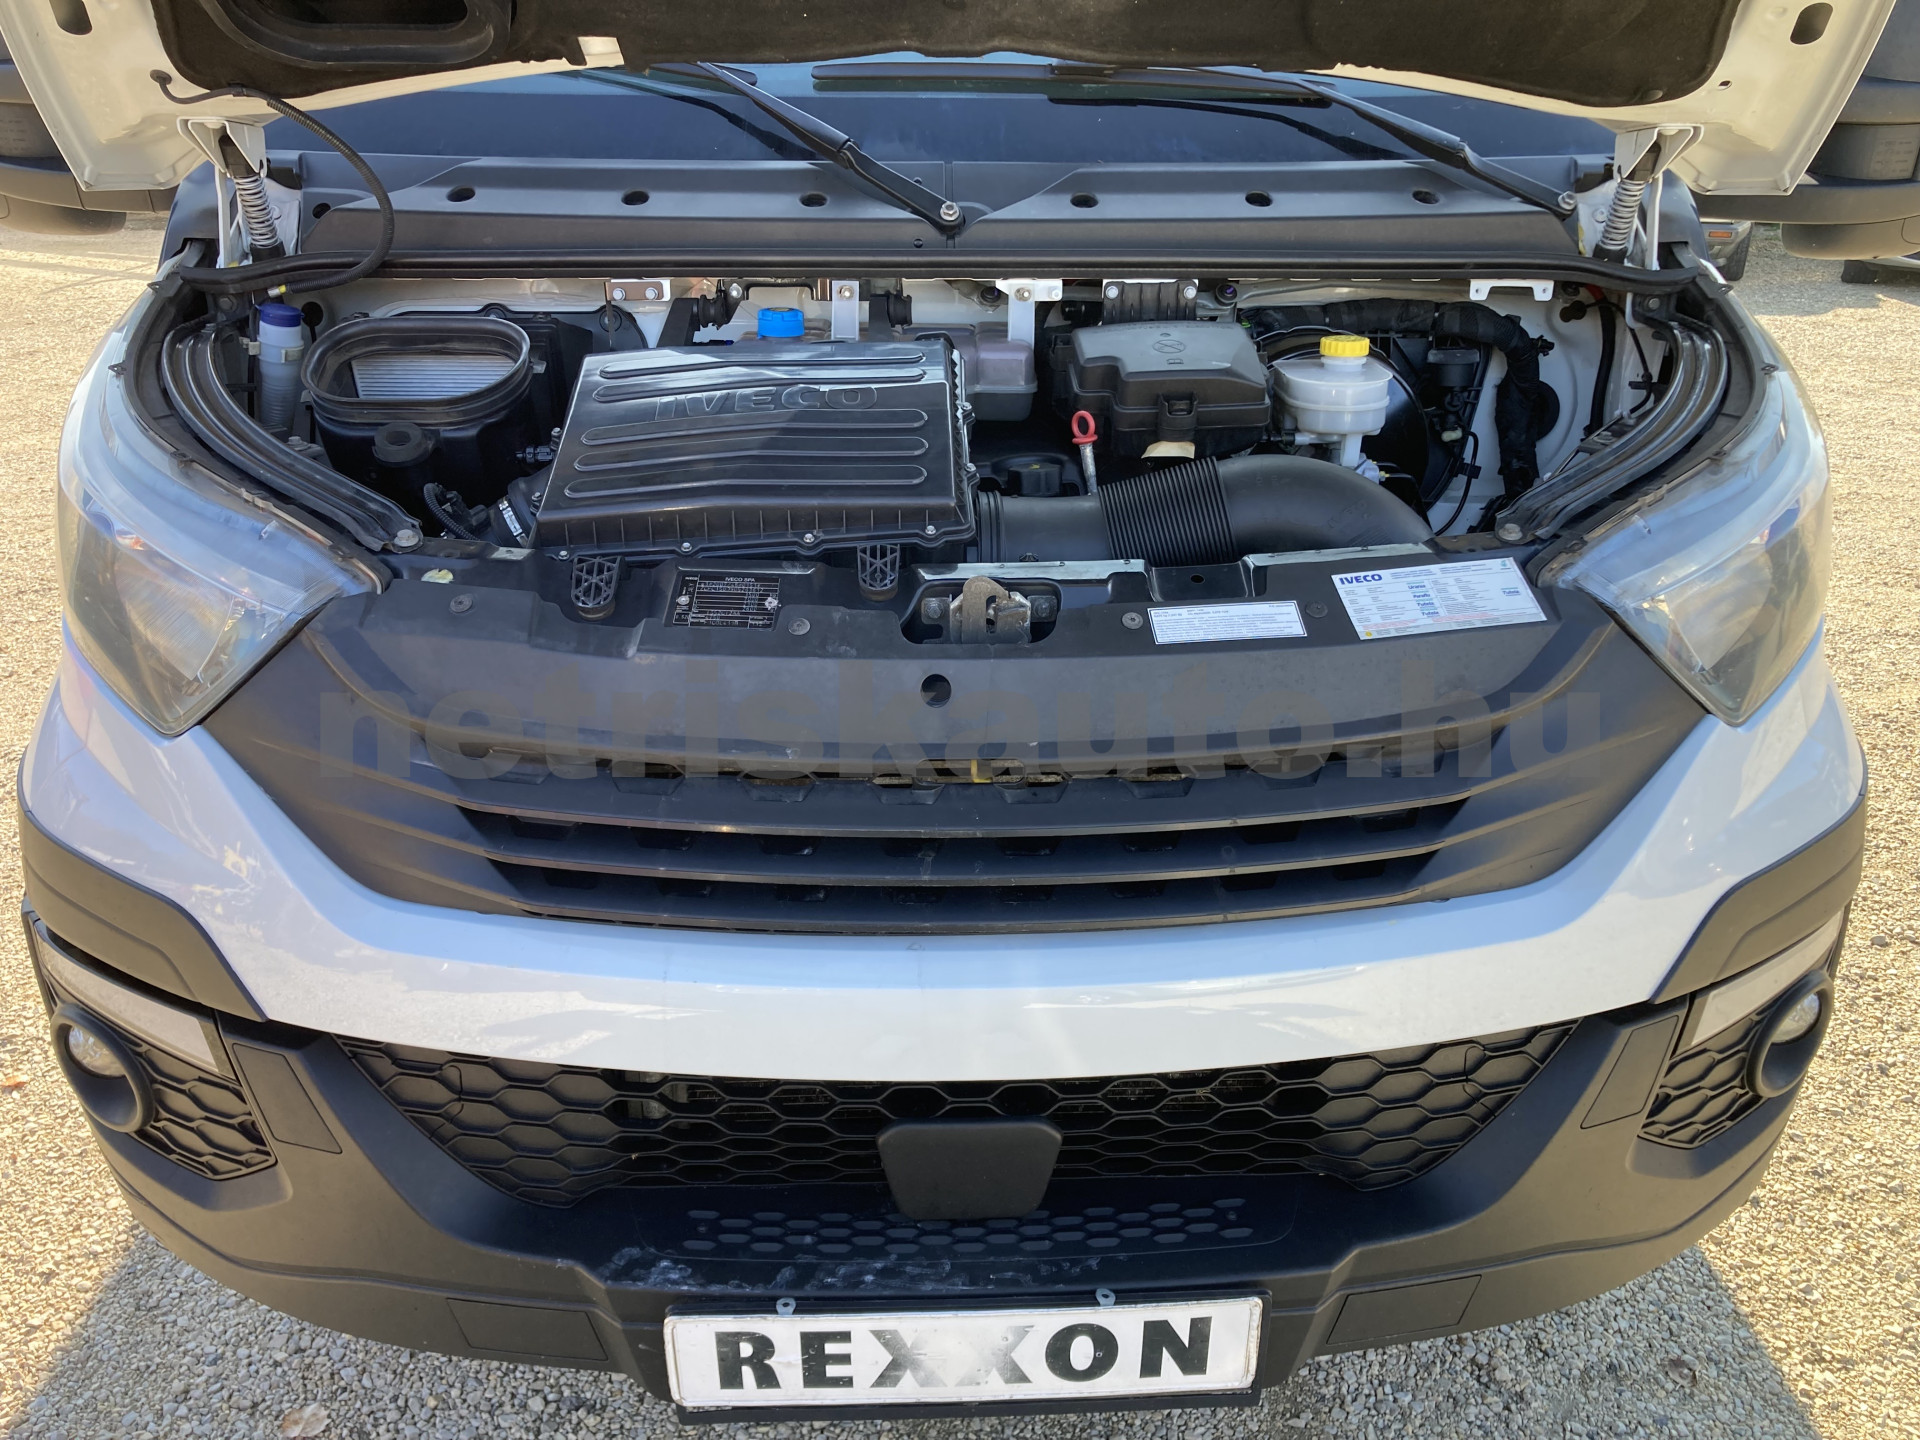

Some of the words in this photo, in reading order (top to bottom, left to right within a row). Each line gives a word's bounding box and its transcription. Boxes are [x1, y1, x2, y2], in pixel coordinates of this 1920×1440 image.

[655, 384, 877, 420] IVECO
[1339, 573, 1382, 585] IVECO
[714, 1315, 1213, 1390] REXXON
